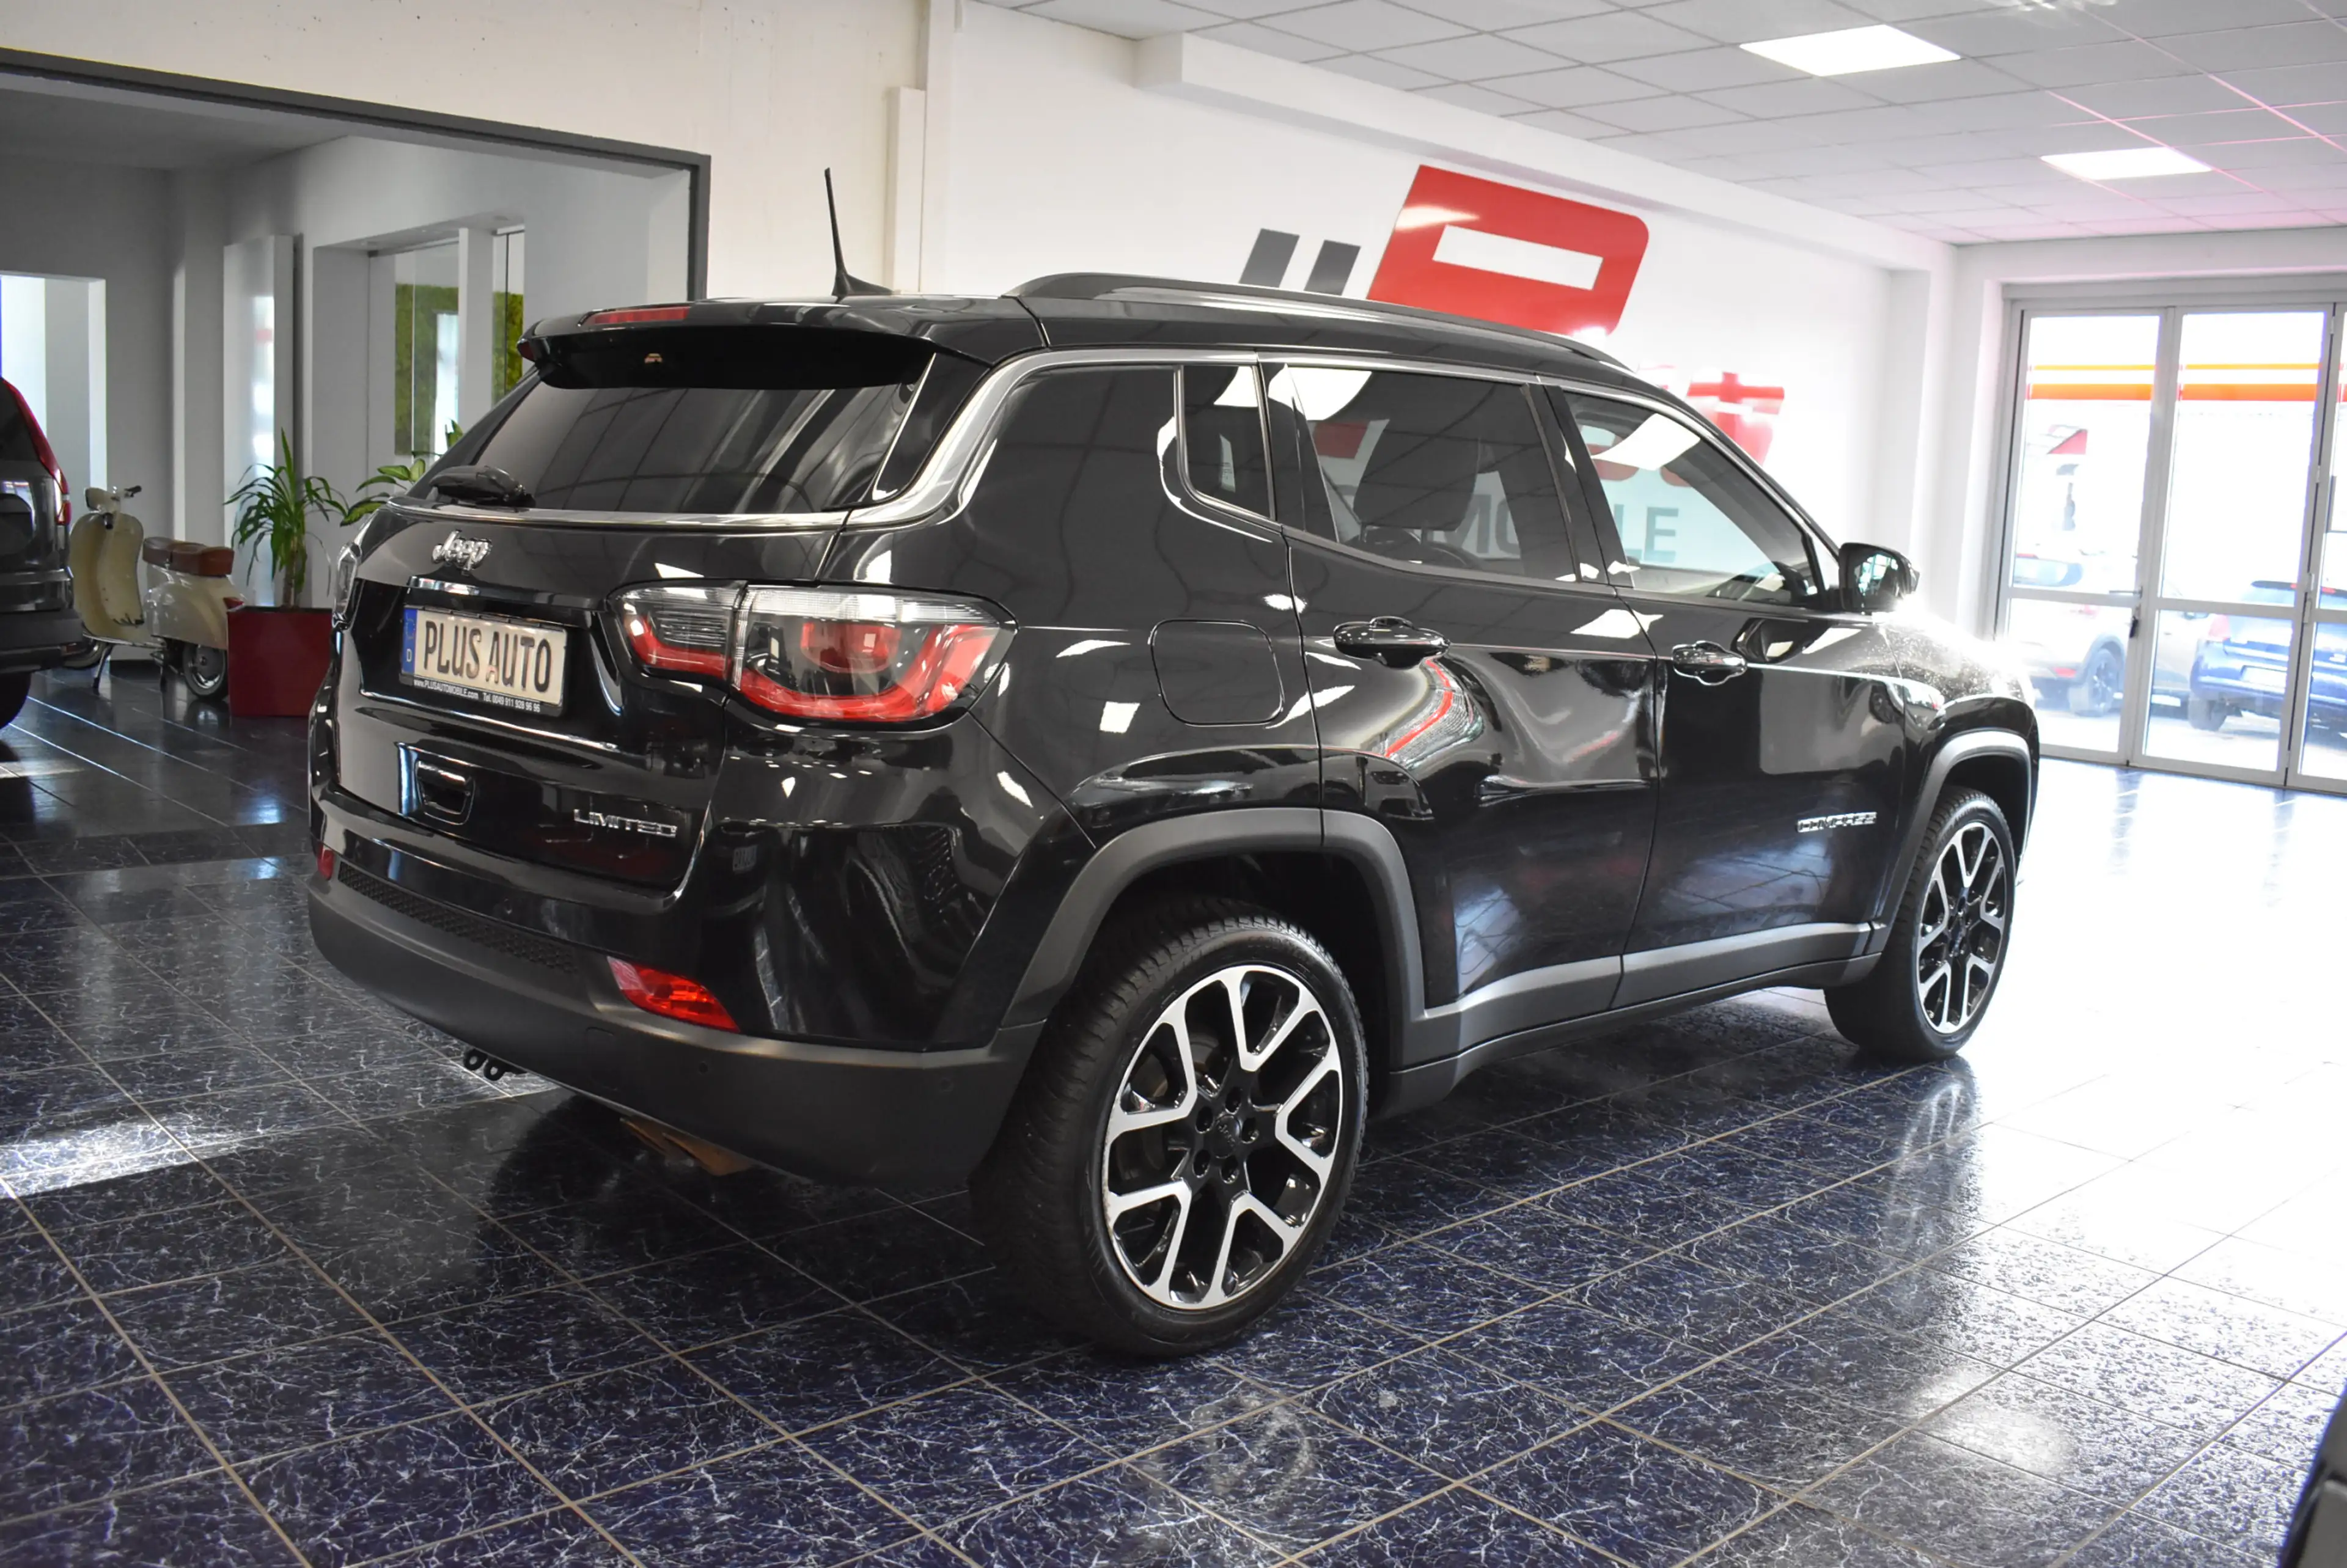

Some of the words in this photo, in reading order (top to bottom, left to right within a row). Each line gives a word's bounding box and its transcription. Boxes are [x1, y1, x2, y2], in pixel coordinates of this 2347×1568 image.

[432, 530, 490, 571] Jeep
[406, 648, 413, 662] D
[424, 620, 482, 679] PLUS
[486, 631, 551, 692] AUTO
[505, 697, 514, 706] 911
[573, 808, 678, 838] LIMITED
